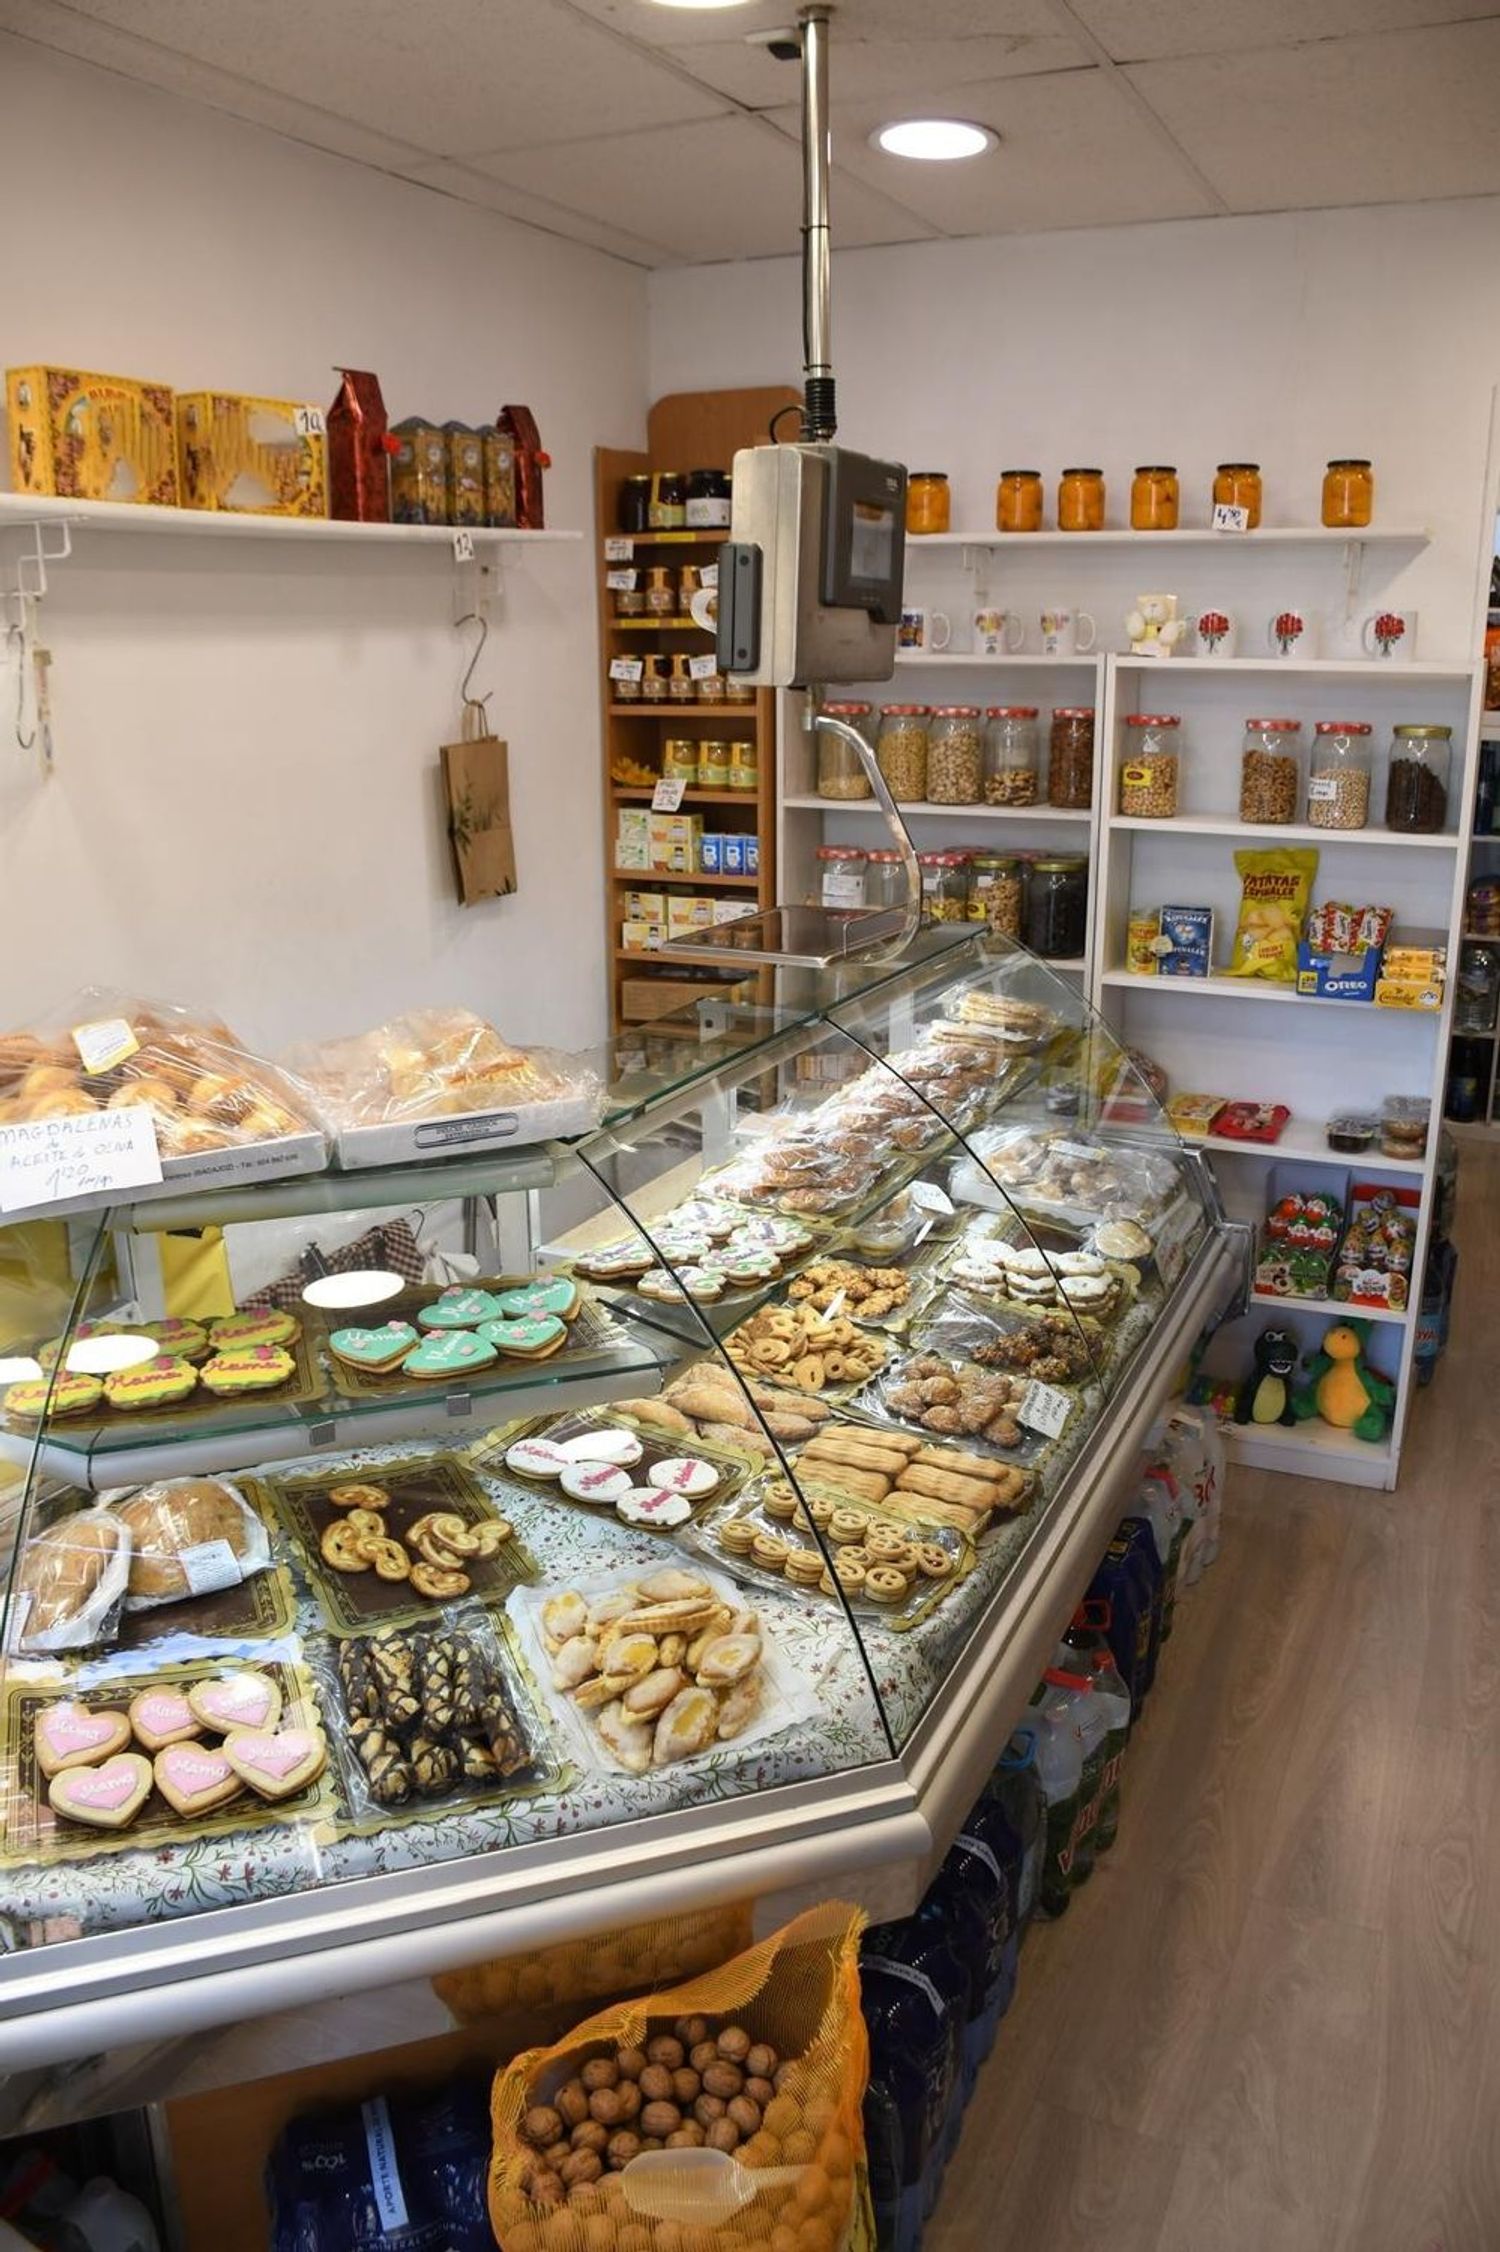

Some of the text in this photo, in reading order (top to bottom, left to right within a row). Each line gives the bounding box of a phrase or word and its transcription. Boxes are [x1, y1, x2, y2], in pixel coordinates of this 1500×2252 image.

[1324, 980, 1368, 992] OREO
[0, 1111, 136, 1143] MAGDALENAS
[10, 1150, 69, 1169] ACEITE
[373, 2129, 387, 2172] NATURAL
[380, 2173, 395, 2214] APORTE
